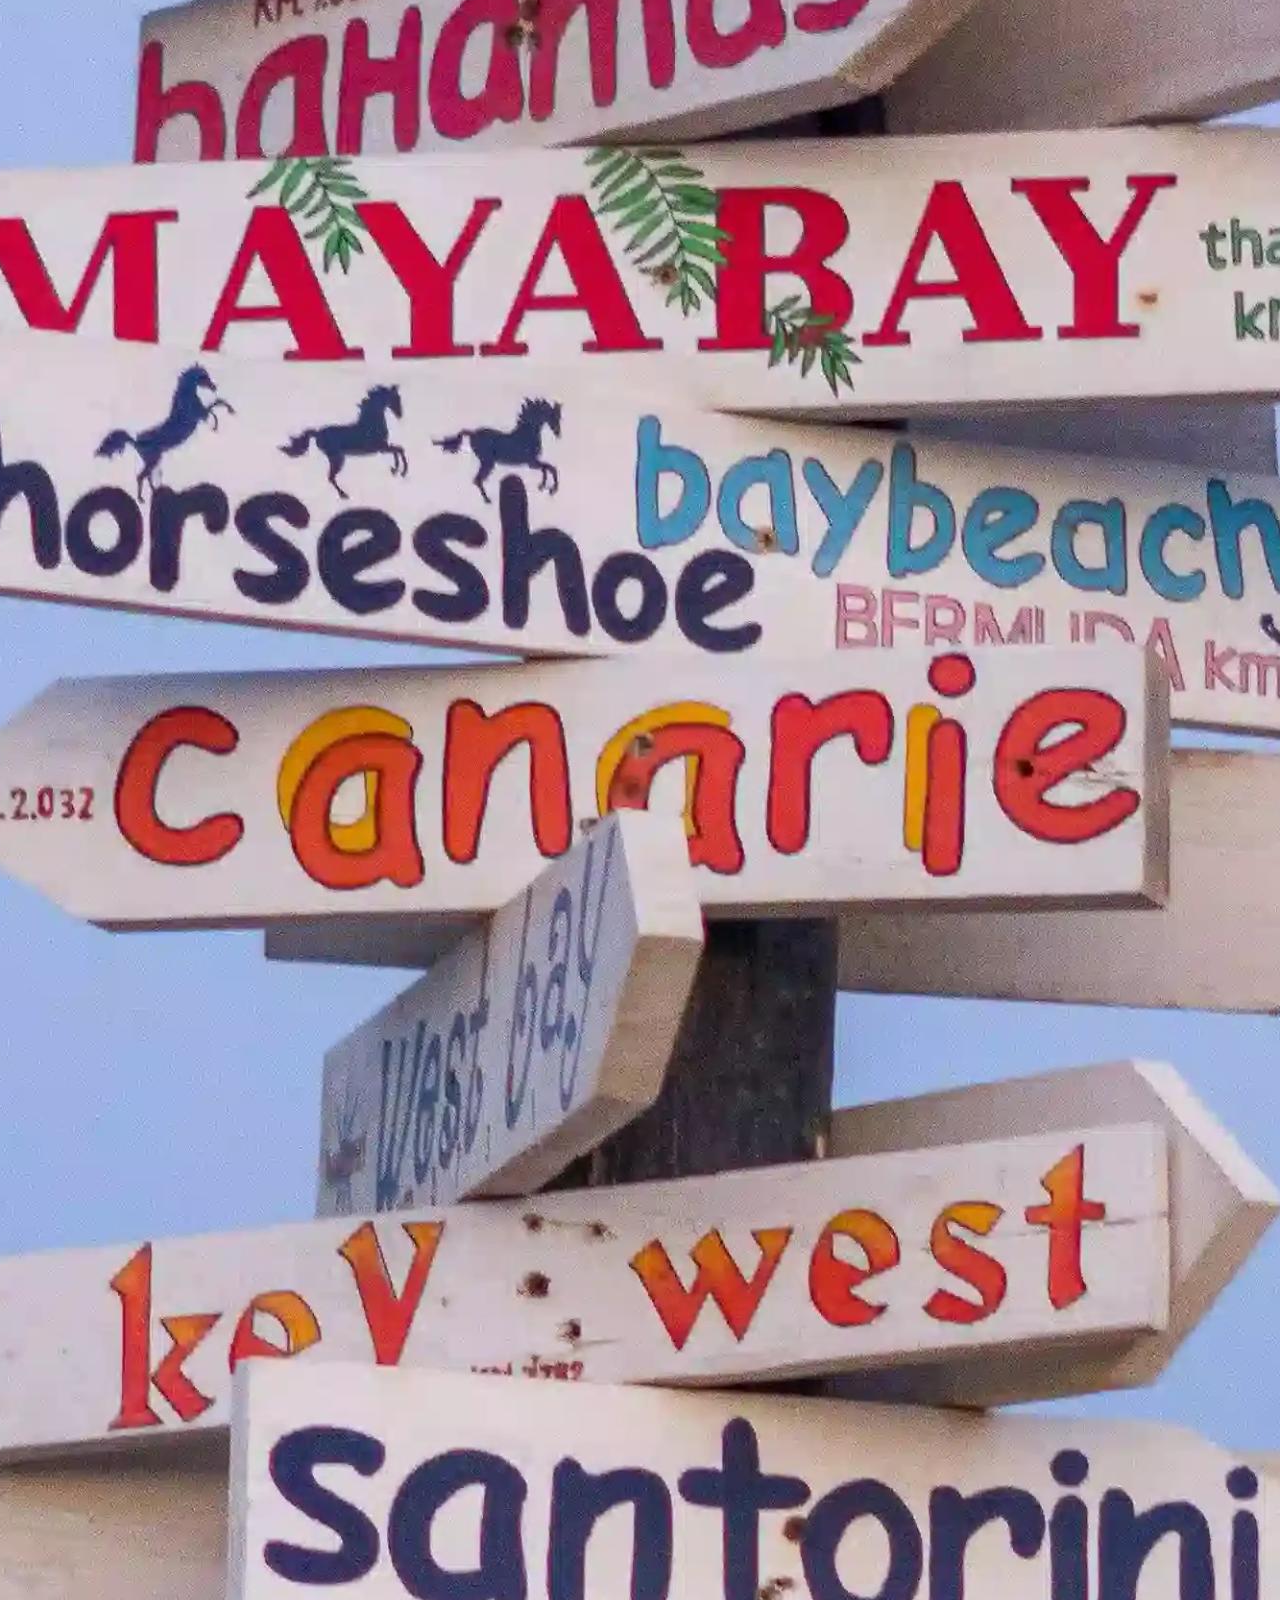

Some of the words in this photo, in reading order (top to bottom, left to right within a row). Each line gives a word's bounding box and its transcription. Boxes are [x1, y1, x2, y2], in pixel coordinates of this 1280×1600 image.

[698, 174, 1178, 351] BAY
[114, 653, 1142, 891] canarie
[630, 1142, 1106, 1353] west
